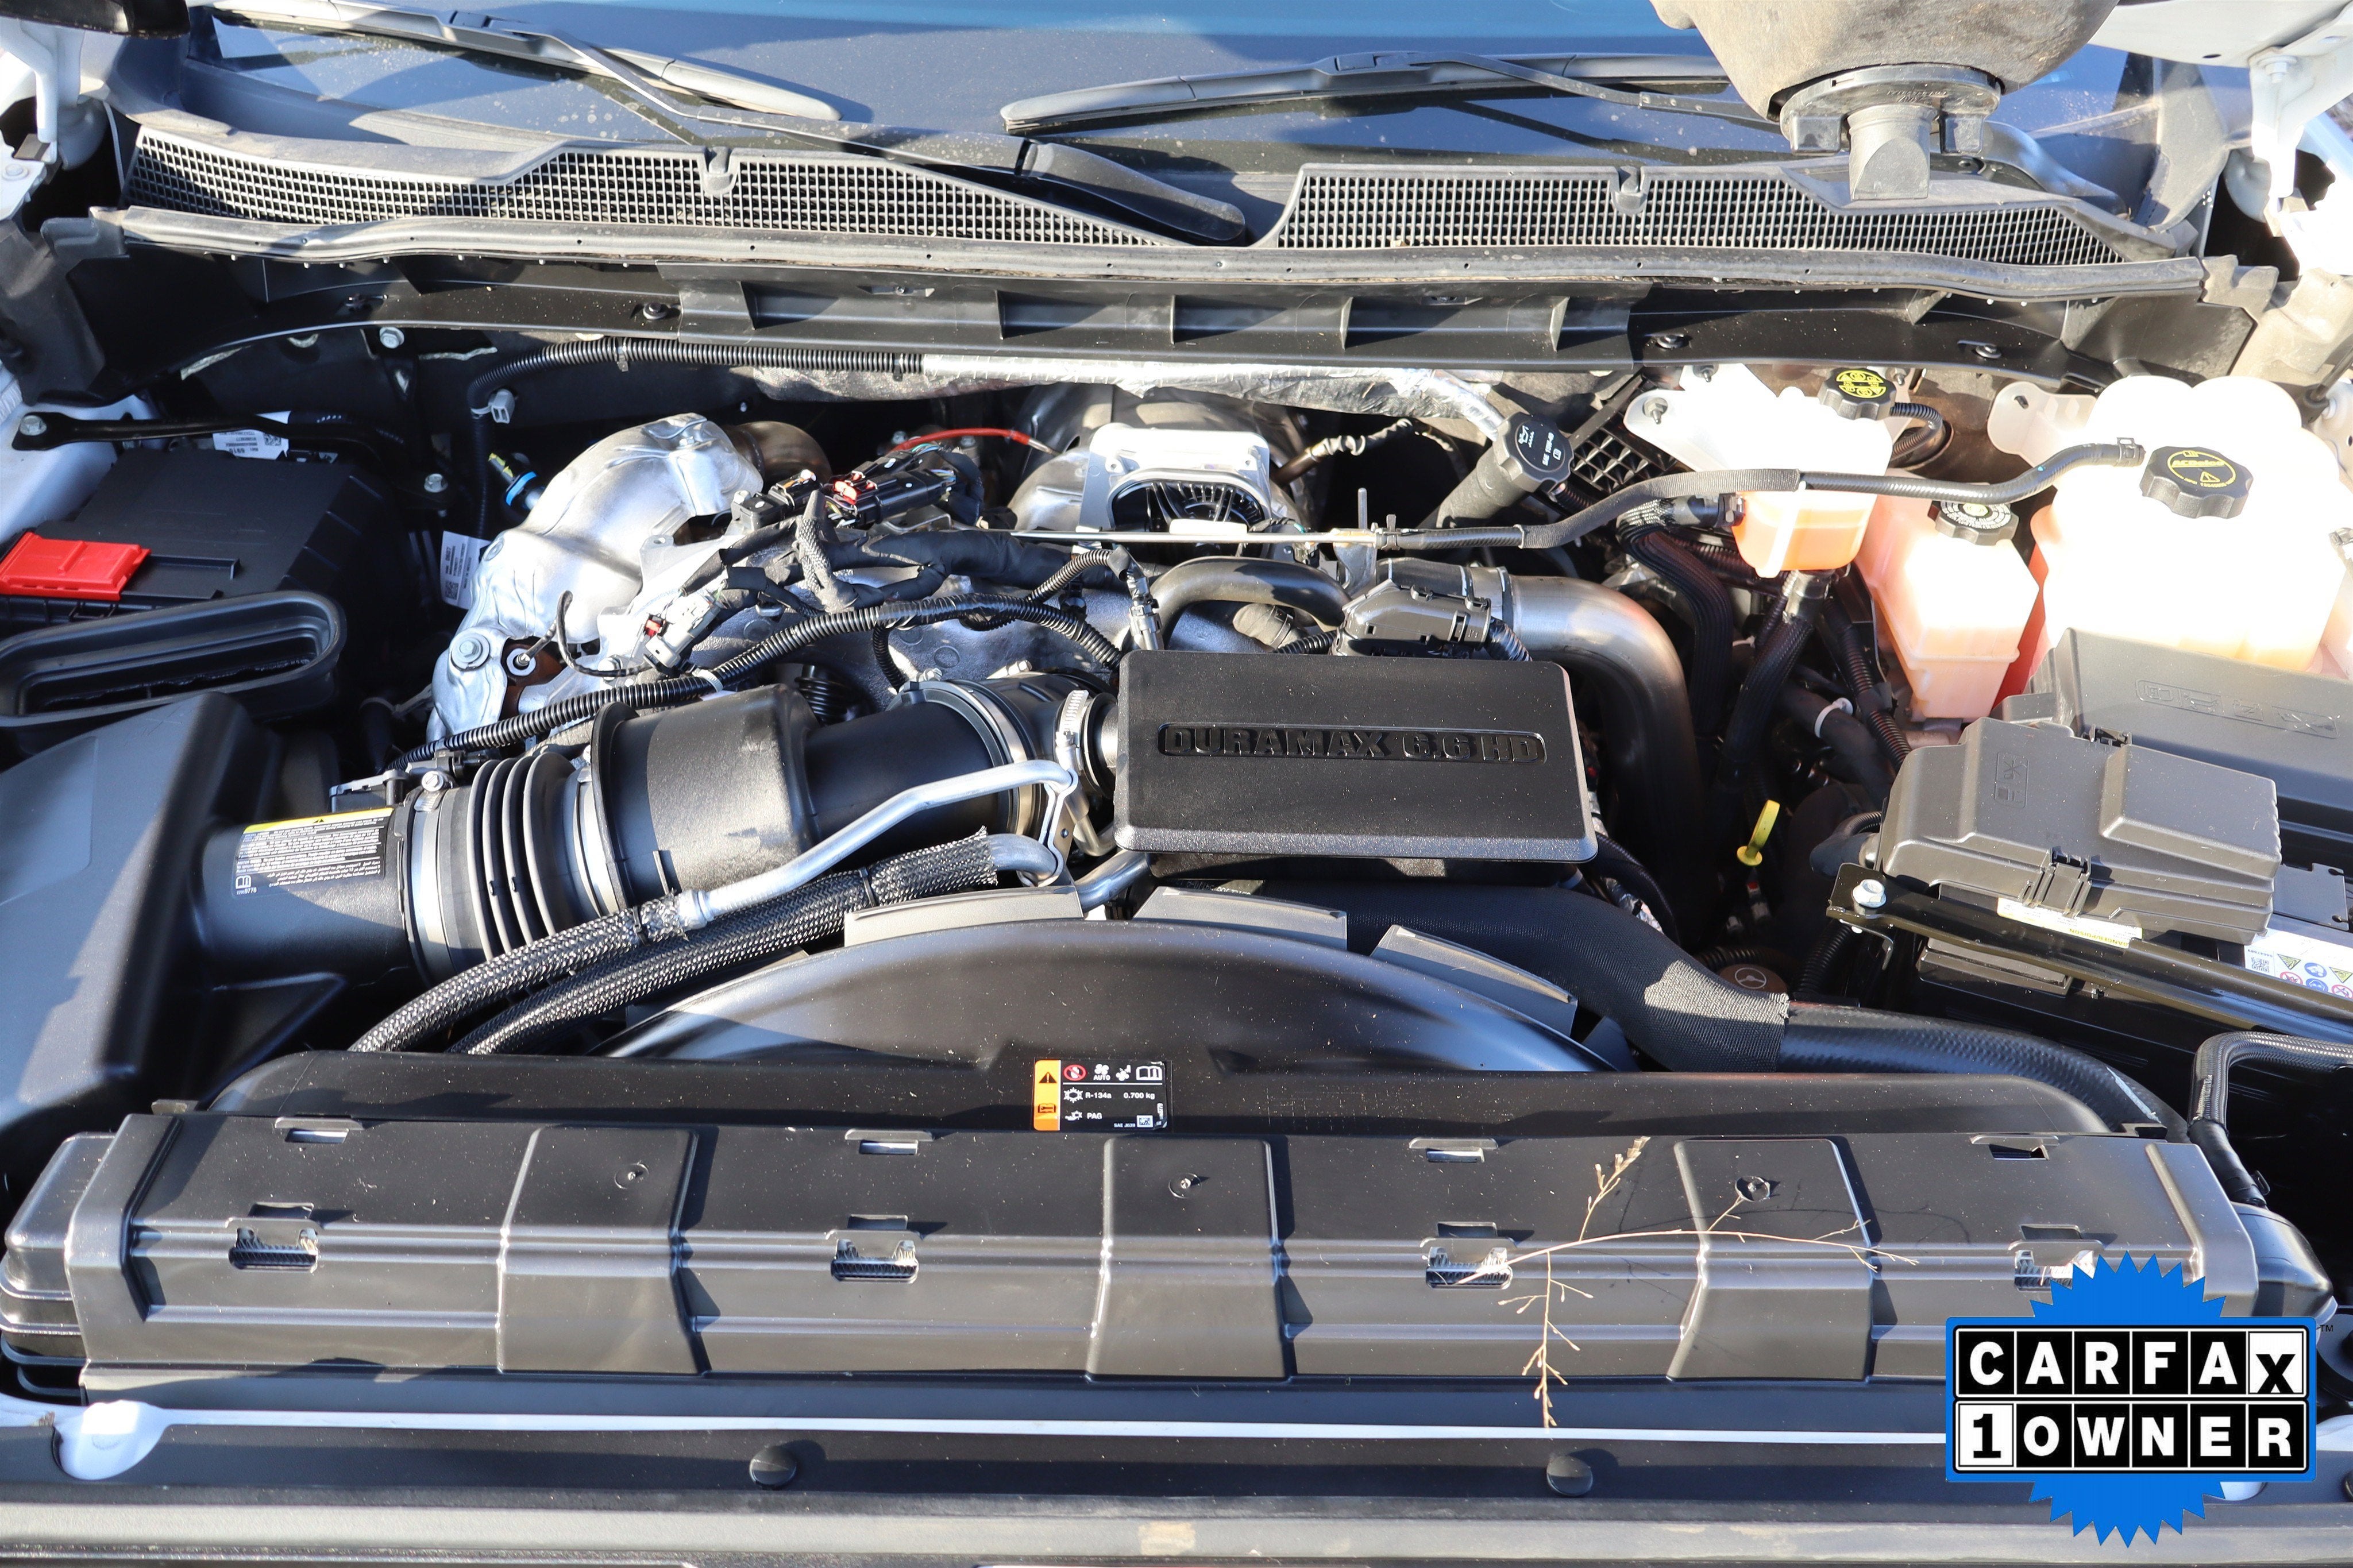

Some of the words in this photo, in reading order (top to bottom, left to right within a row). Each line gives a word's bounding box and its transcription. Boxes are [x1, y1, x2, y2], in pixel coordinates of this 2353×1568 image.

[2171, 459, 2225, 468] ACDelco
[1164, 727, 1386, 758] DURAMAX
[1402, 732, 1471, 759] 6.6
[1480, 734, 1539, 763] HD
